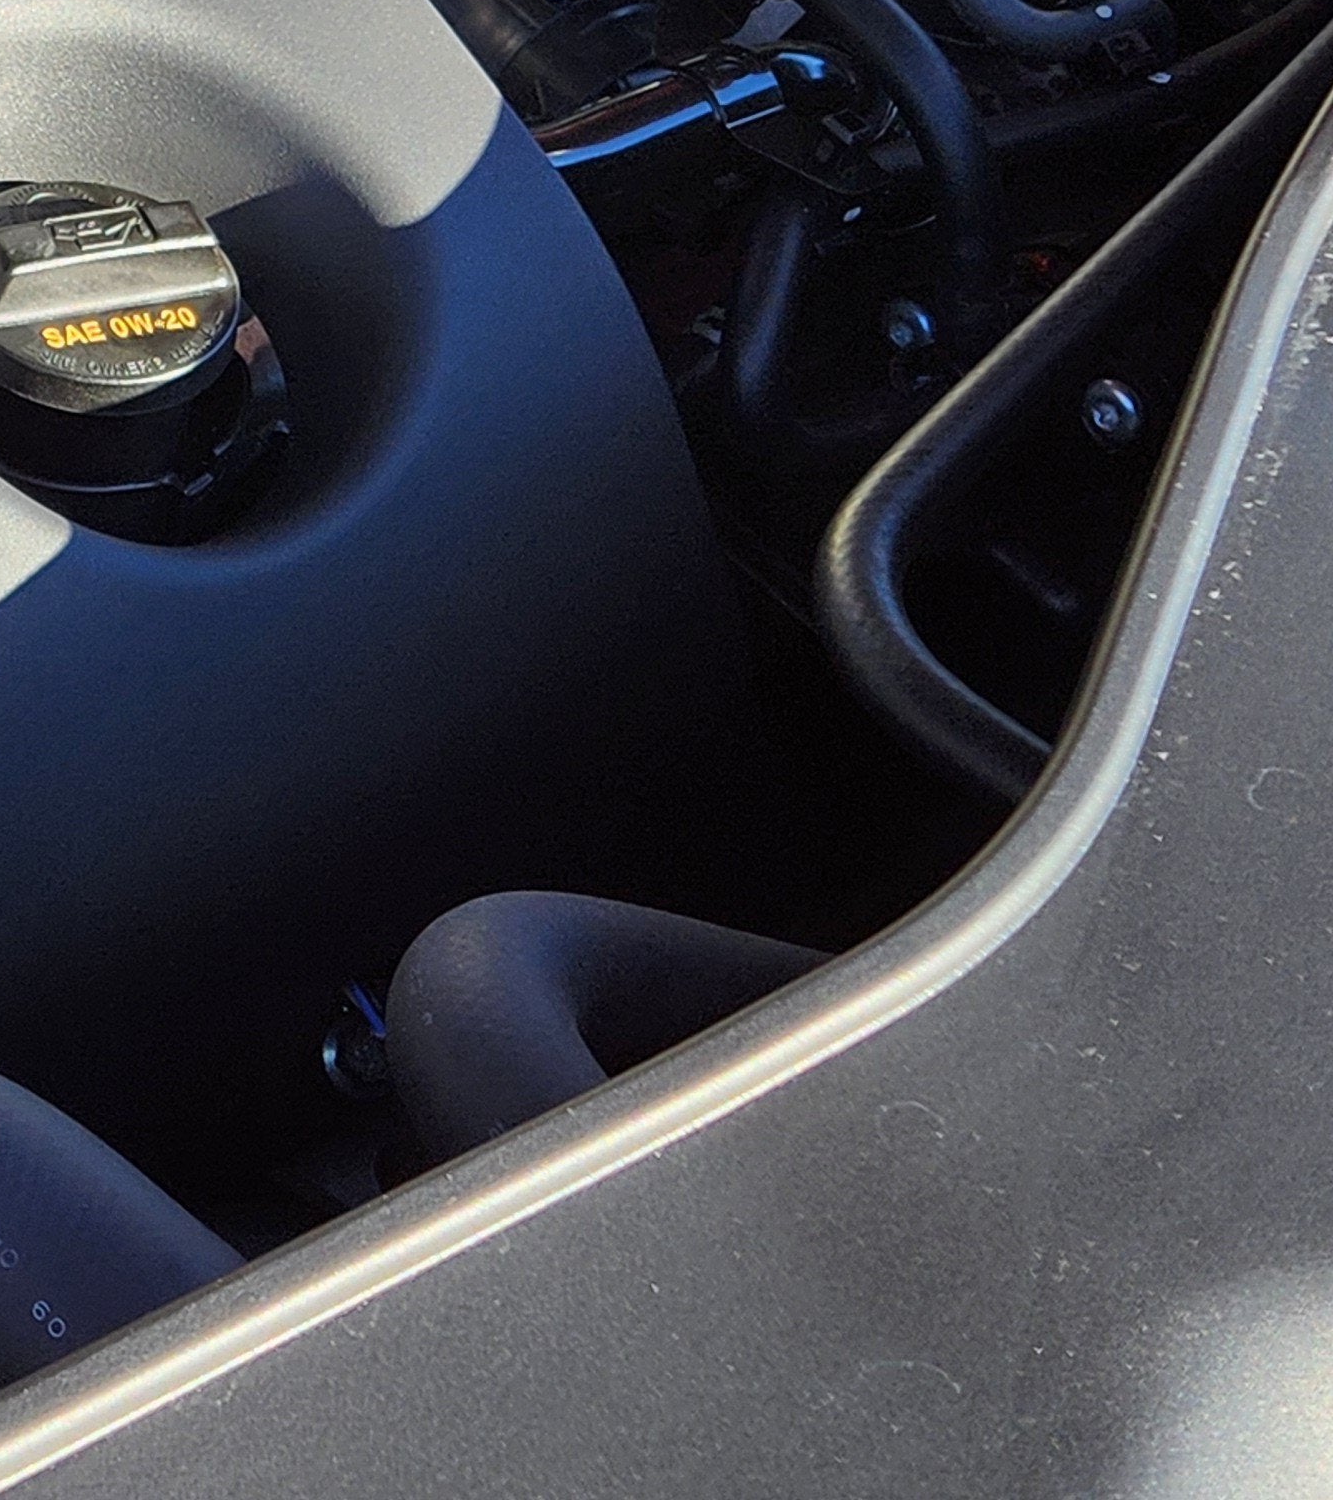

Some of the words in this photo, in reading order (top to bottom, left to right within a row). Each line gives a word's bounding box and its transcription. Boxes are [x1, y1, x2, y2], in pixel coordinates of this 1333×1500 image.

[41, 320, 107, 350] SAE
[108, 306, 198, 338] 0W-20
[31, 1299, 67, 1339] 09
